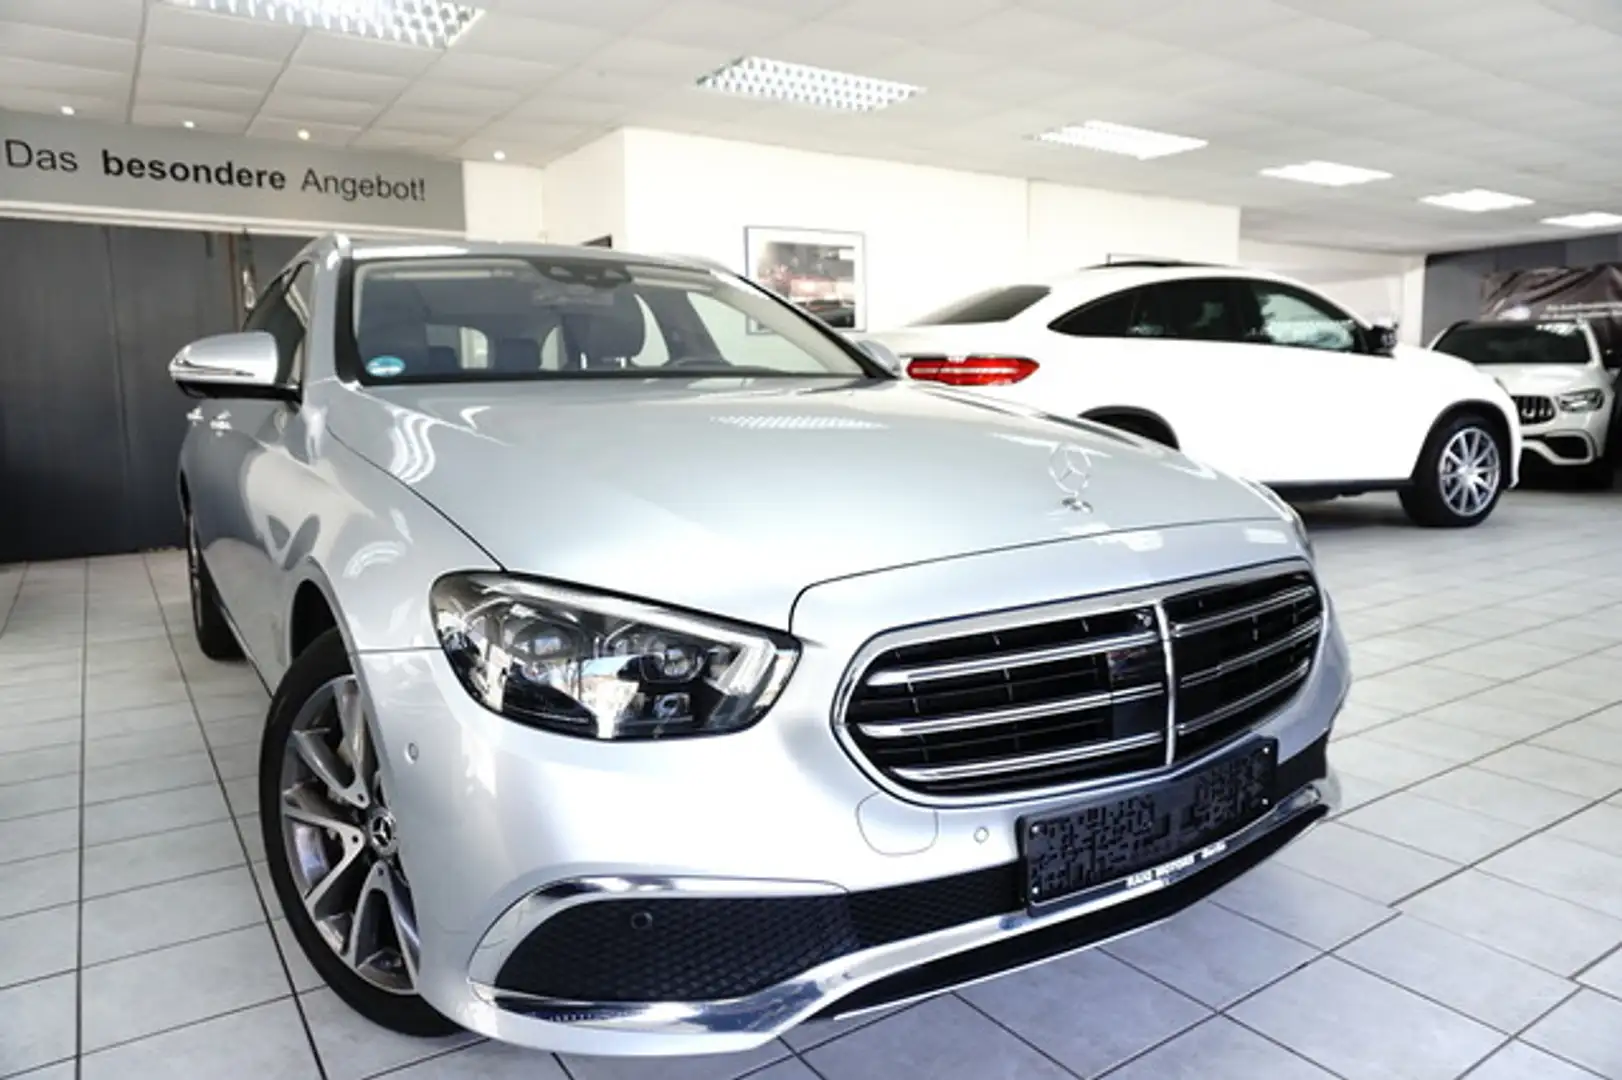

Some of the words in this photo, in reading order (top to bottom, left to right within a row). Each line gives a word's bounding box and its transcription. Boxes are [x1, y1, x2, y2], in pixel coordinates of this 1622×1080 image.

[5, 139, 79, 173] Das
[102, 149, 287, 190] besondere
[300, 168, 426, 202] Angebot!
